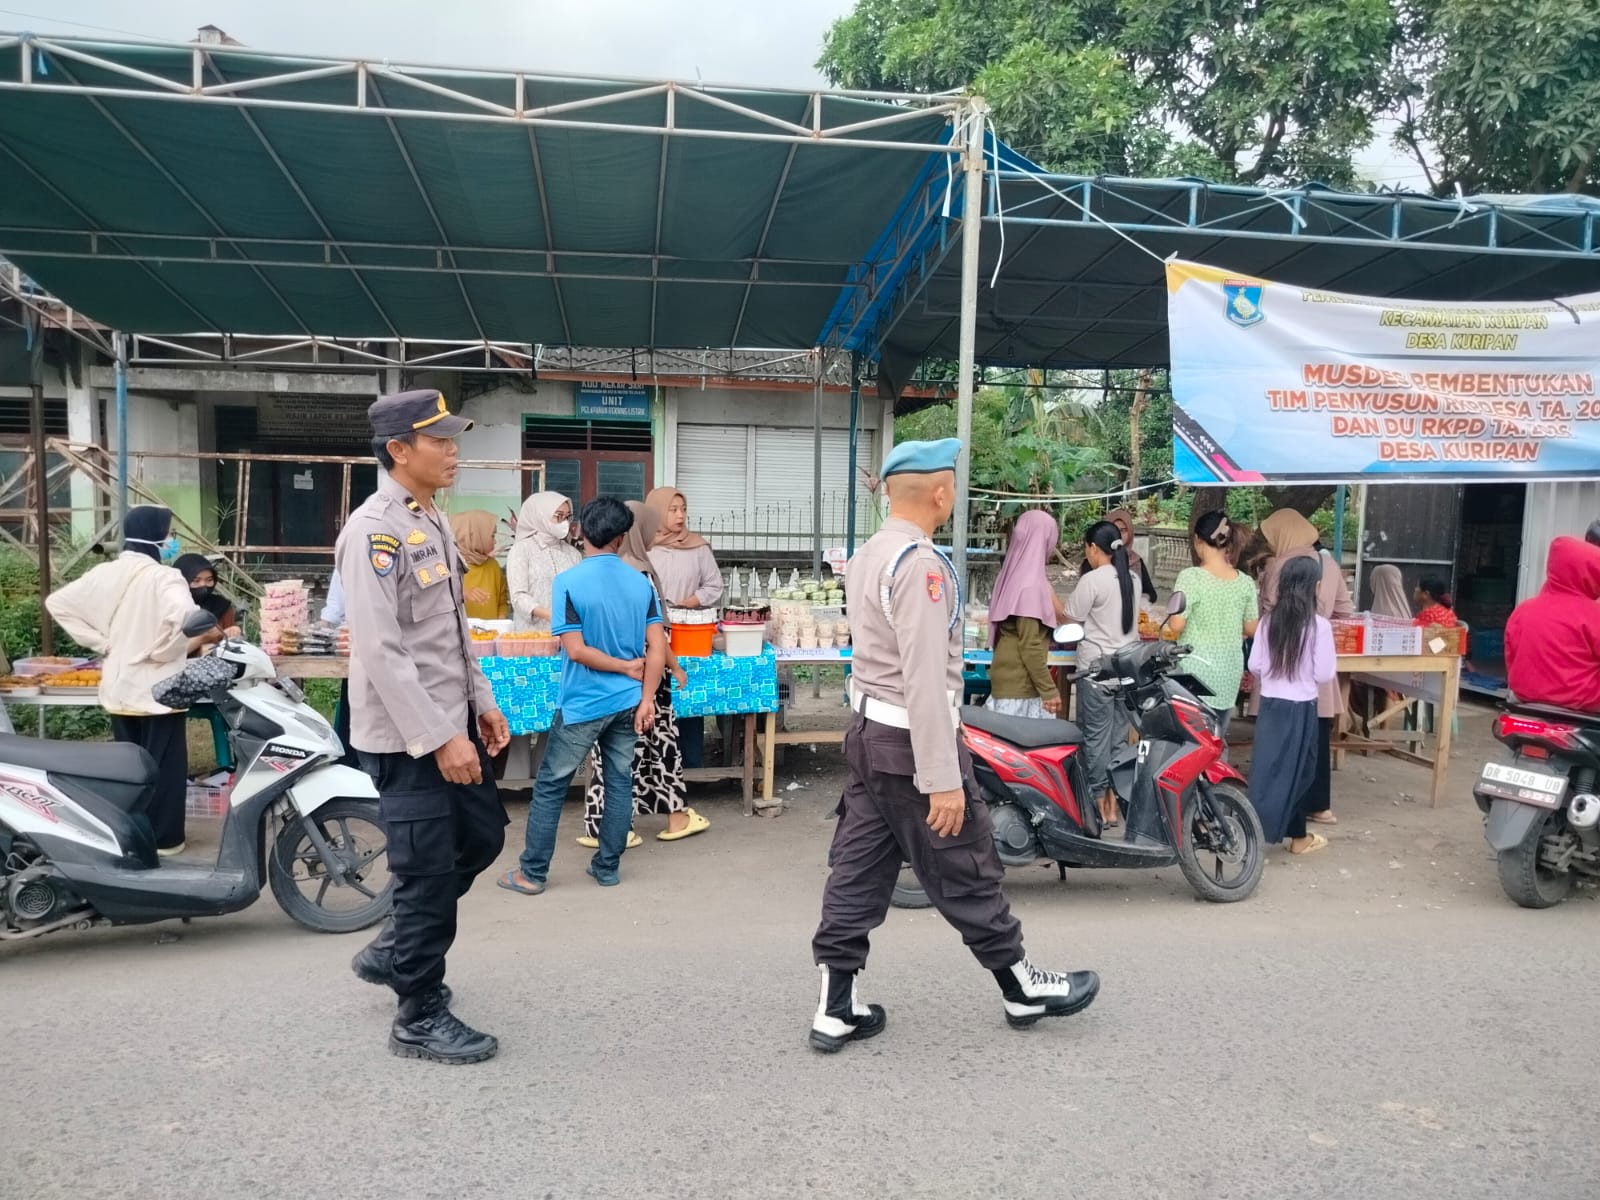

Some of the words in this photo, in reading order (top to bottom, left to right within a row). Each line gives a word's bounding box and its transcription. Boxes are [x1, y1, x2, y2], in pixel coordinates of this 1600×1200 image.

[1379, 310, 1483, 329] KECAMATAN
[1405, 333, 1447, 349] DESA
[1450, 333, 1518, 351] KURIPAN
[1410, 372, 1594, 394] PEMBENTUKAN
[601, 396, 624, 406] UNIT
[1267, 390, 1308, 408] TIM
[1312, 391, 1439, 411] PENYUSUN
[1538, 399, 1571, 418] TA.
[1333, 415, 1380, 434] DAN
[1384, 417, 1415, 435] DU
[1422, 417, 1486, 436] RKPD
[1490, 418, 1526, 436] TA.
[1379, 440, 1437, 460] DESA
[1441, 441, 1540, 460] KURIPAN
[410, 544, 438, 563] IMRAN
[270, 745, 307, 758] HONDA
[1485, 766, 1501, 778] DR
[1505, 770, 1537, 786] 5048
